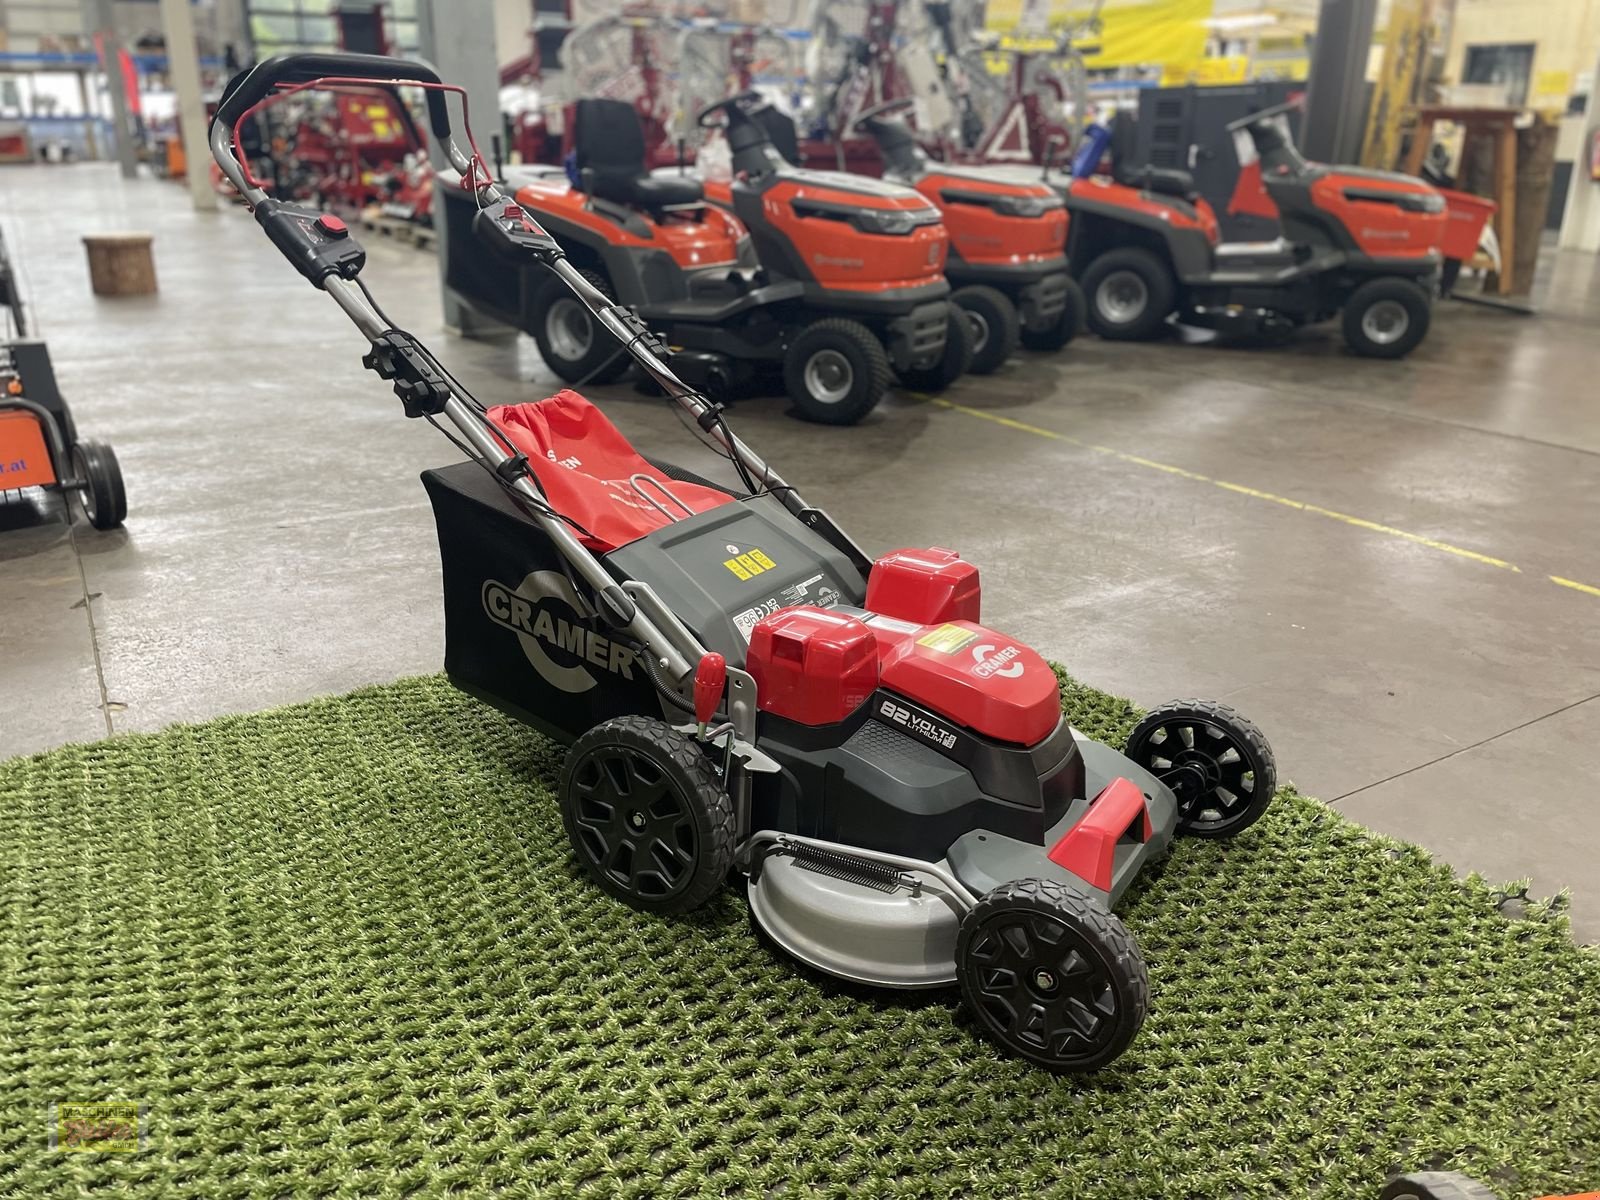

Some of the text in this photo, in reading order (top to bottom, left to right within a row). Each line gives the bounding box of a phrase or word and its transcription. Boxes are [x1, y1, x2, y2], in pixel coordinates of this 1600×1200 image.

[487, 587, 634, 681] CRAMER
[743, 613, 757, 628] 96
[977, 645, 1021, 676] CRAMER
[880, 700, 911, 725] 82
[911, 714, 949, 739] VOLT
[907, 722, 943, 744] LITHIUM
